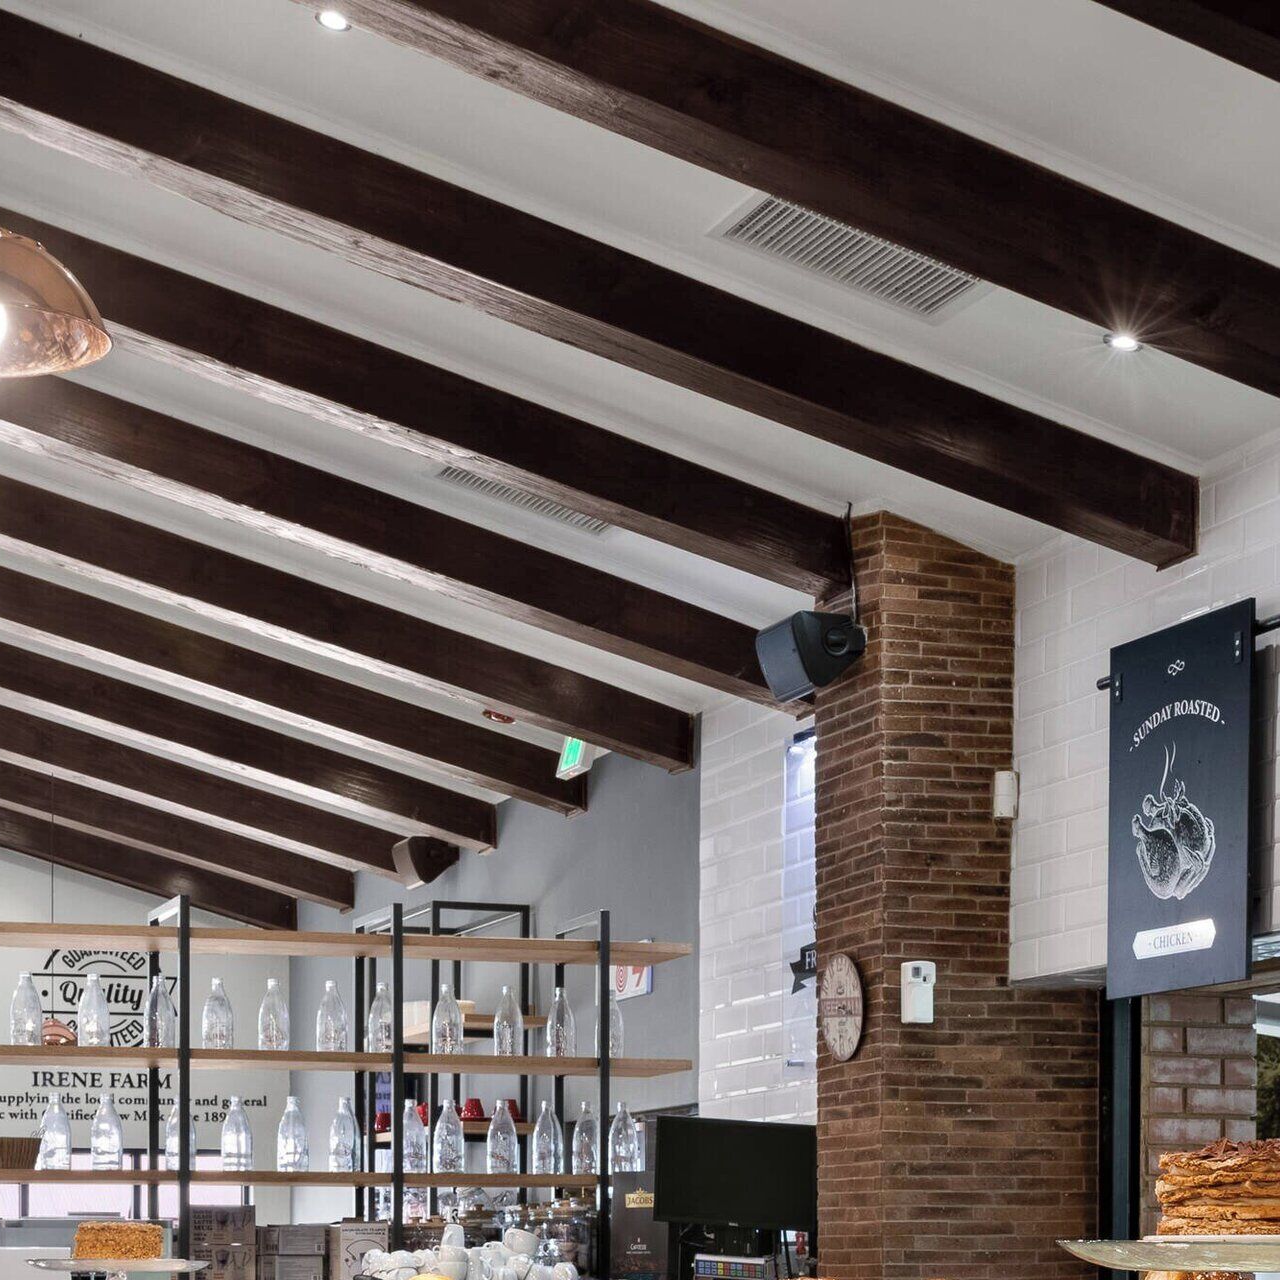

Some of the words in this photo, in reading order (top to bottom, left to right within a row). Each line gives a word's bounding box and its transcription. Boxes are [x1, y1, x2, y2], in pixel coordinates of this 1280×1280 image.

[1133, 703, 1172, 748] SUNDAY
[1173, 699, 1220, 724] ROASTED
[1153, 931, 1194, 950] CHICKEN
[32, 1071, 103, 1088] IRENE
[61, 1093, 84, 1104] the
[195, 1095, 218, 1107] and
[8, 1108, 37, 1120] with
